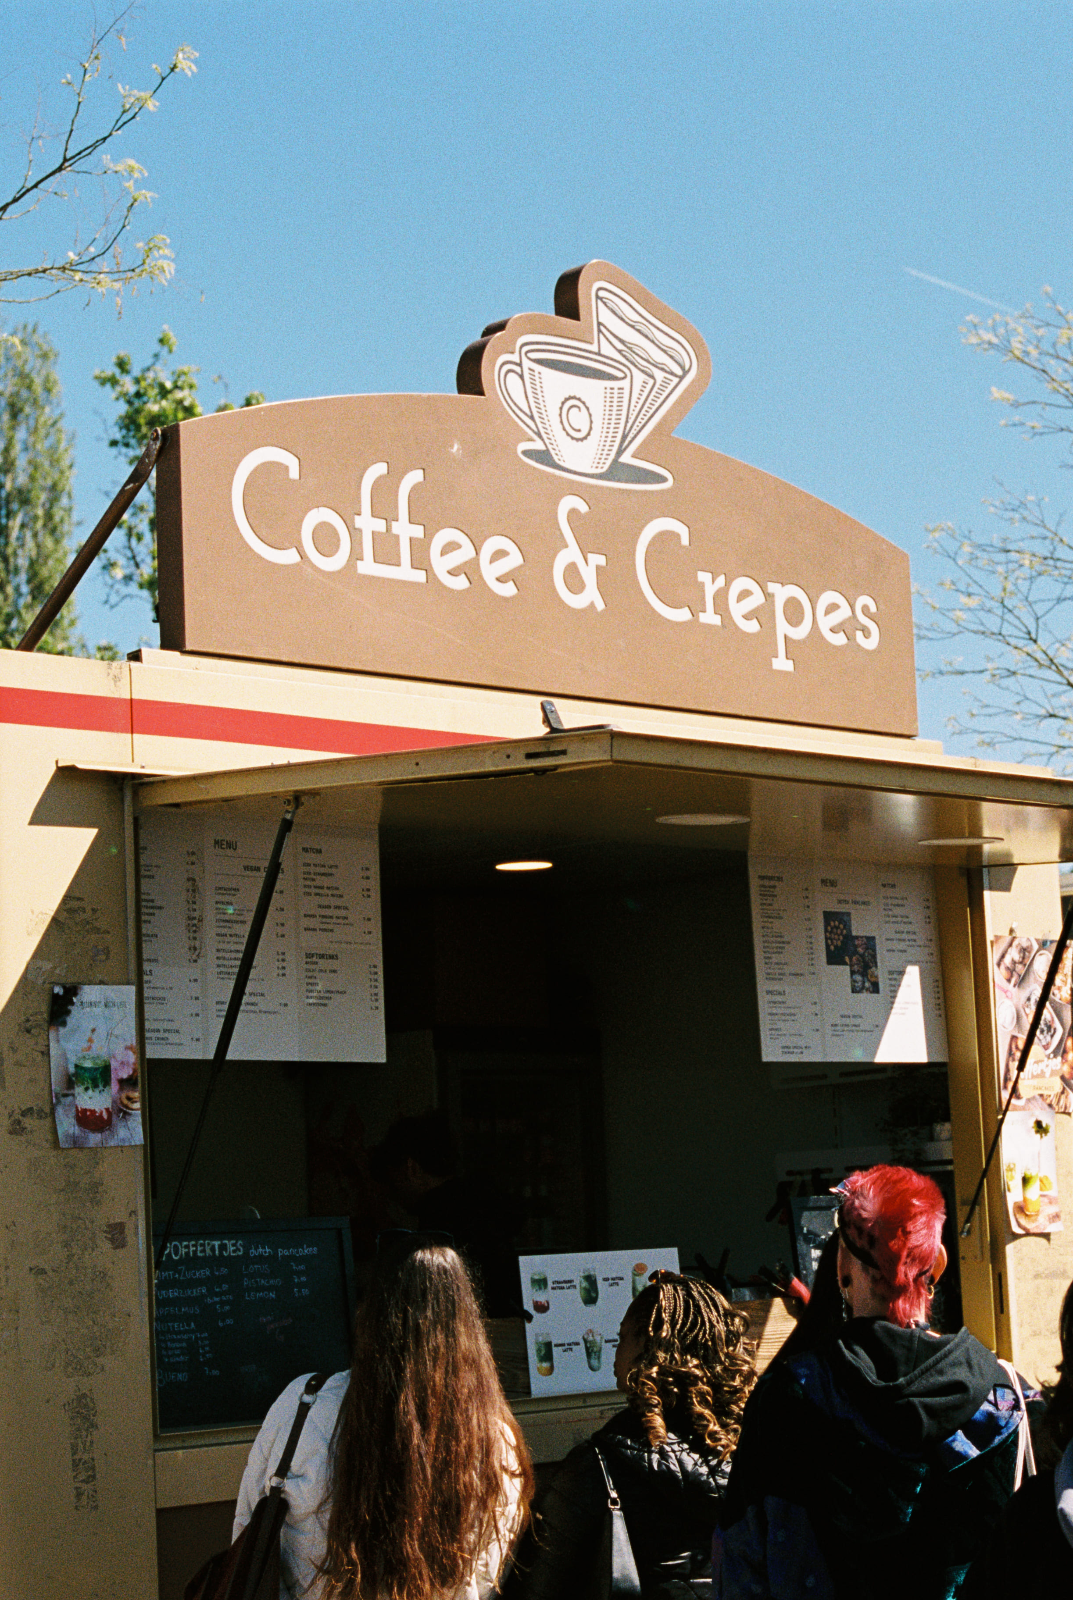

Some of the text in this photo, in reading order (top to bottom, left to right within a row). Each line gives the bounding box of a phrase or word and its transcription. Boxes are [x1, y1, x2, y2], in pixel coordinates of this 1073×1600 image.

[231, 445, 880, 672] Coffee & Crepes
[214, 839, 238, 850] MENU
[305, 952, 339, 961] SOFTDRINKS
[249, 1244, 273, 1257] dutch
[278, 1244, 318, 1260] pancakes
[155, 1286, 207, 1300] UDERZUCKER
[245, 1290, 276, 1300] LEMON
